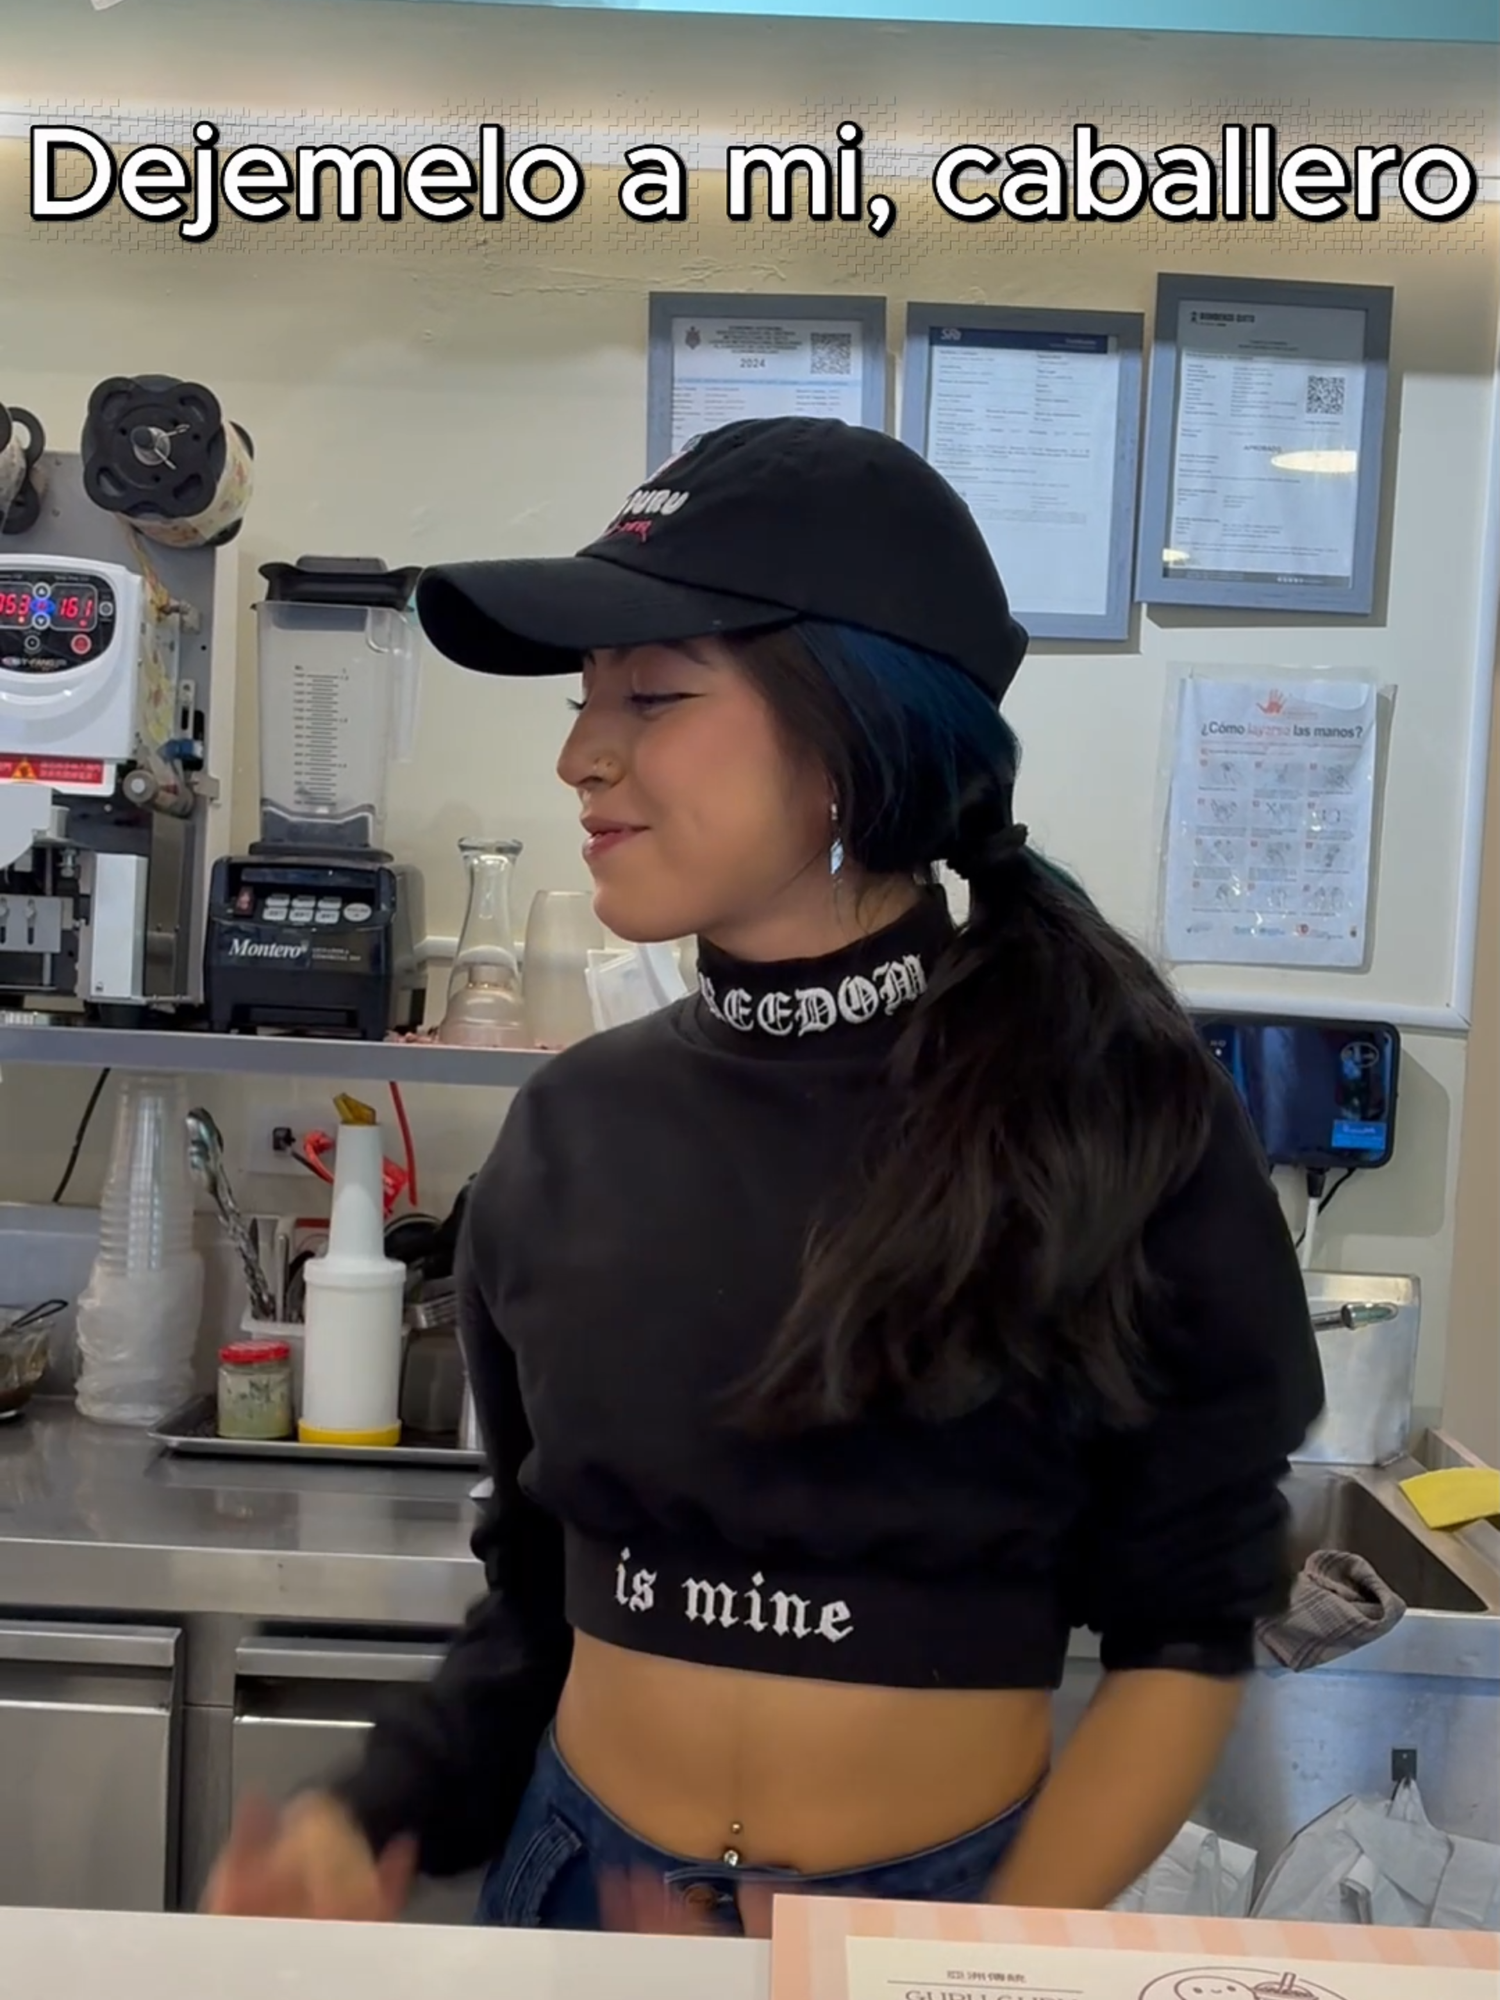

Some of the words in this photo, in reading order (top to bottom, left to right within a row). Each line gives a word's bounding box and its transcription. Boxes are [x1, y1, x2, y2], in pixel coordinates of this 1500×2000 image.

[740, 358, 766, 368] 2024
[621, 488, 690, 516] URU
[1201, 720, 1245, 737] ¿Cómo
[1293, 724, 1311, 737] las
[1313, 725, 1363, 739] manos?
[228, 937, 302, 959] Montero
[614, 1546, 658, 1612] is
[681, 1570, 855, 1643] mine
